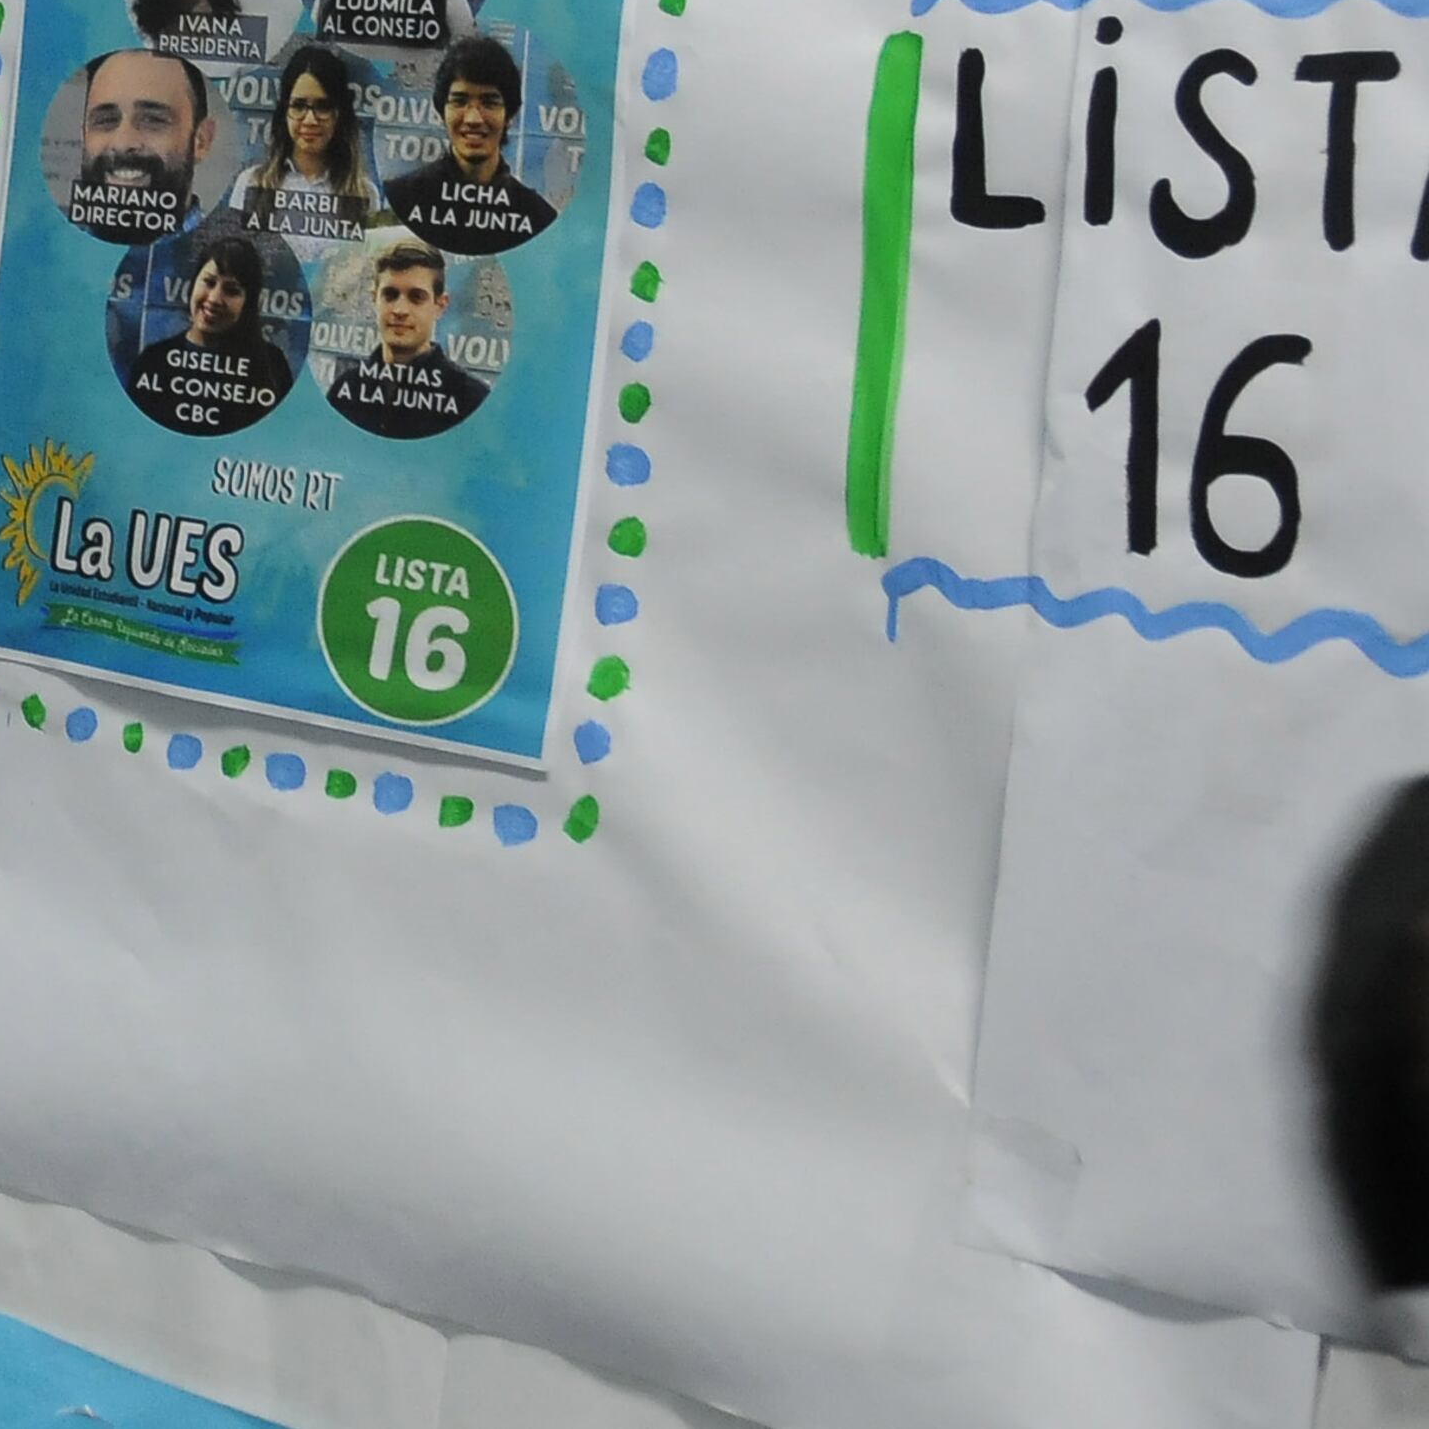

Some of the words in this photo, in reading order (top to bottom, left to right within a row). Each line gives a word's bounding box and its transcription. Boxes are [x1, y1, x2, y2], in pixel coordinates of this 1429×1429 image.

[178, 15, 244, 37] IVANA
[322, 14, 343, 35] AL
[352, 14, 441, 41] CONSEJO
[158, 33, 263, 60] PRESIDENTA
[71, 183, 178, 210] MARIANO
[273, 189, 339, 214] BARBI
[440, 181, 511, 207] LICHA
[70, 206, 178, 233] DIRECTOR
[246, 211, 262, 230] A
[267, 213, 293, 233] LA
[296, 216, 367, 243] JUNTA
[408, 203, 424, 223] A
[429, 205, 457, 227] LA
[462, 208, 535, 236] JUNTA
[164, 349, 251, 379] GISELLE
[358, 360, 444, 389] MATIAS
[134, 371, 164, 394] AL
[169, 375, 277, 408] CONSEJO
[336, 381, 353, 401] A
[359, 382, 386, 404] LA
[392, 387, 461, 416] JUNTA
[175, 402, 222, 428] CBC
[1084, 316, 1313, 578] 16
[211, 456, 297, 506] SOMOS
[302, 471, 345, 512] RT
[49, 495, 116, 582] La
[125, 508, 246, 606] UES
[375, 553, 471, 600] LISTA
[364, 596, 471, 693] 16
